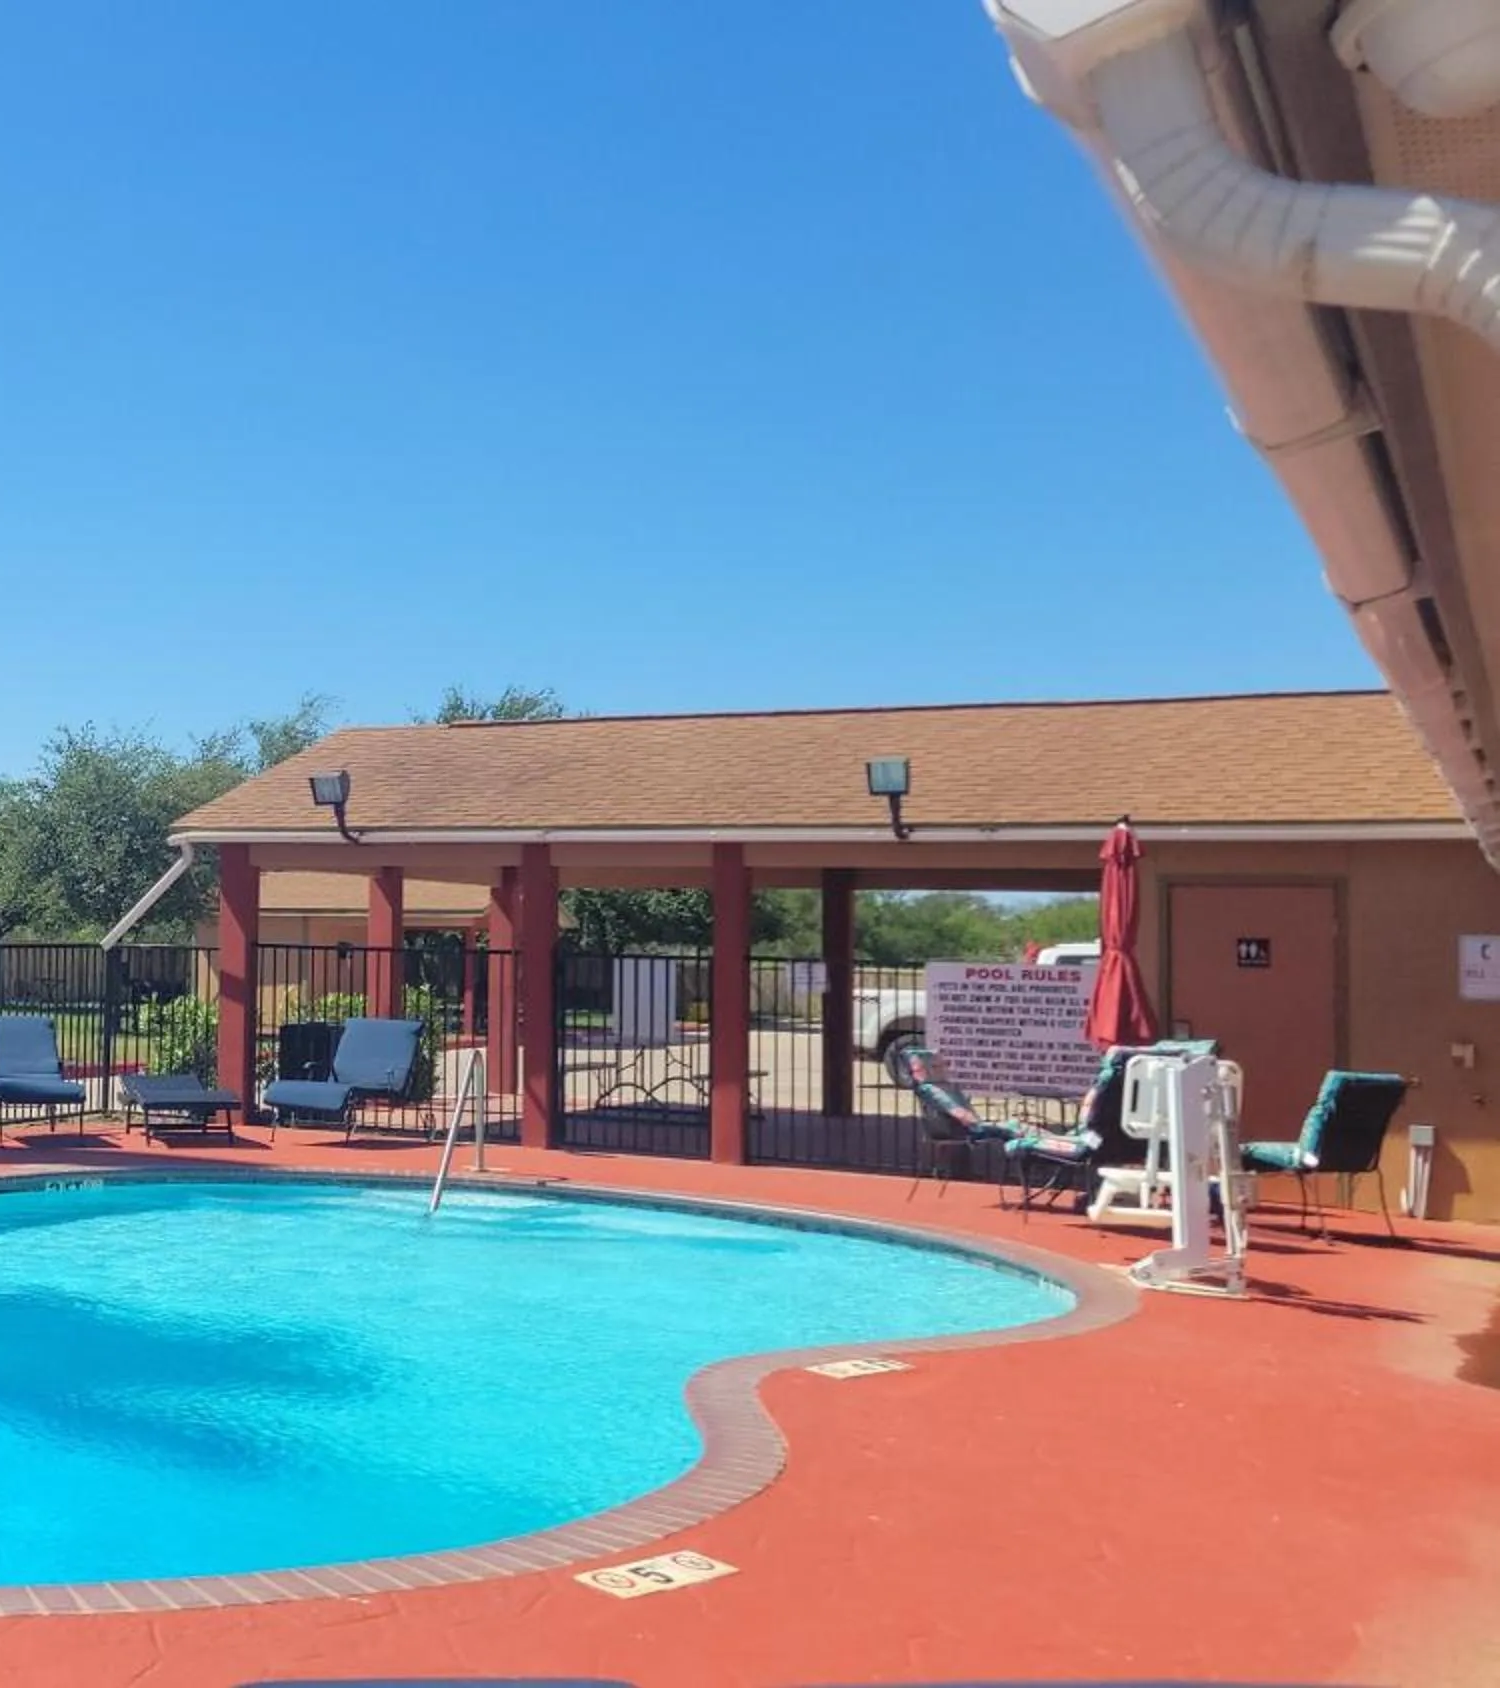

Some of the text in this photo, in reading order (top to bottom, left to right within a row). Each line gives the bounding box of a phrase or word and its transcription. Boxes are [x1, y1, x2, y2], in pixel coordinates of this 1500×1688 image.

[965, 968, 1083, 982] POOL RULES
[626, 1566, 674, 1584] 5
